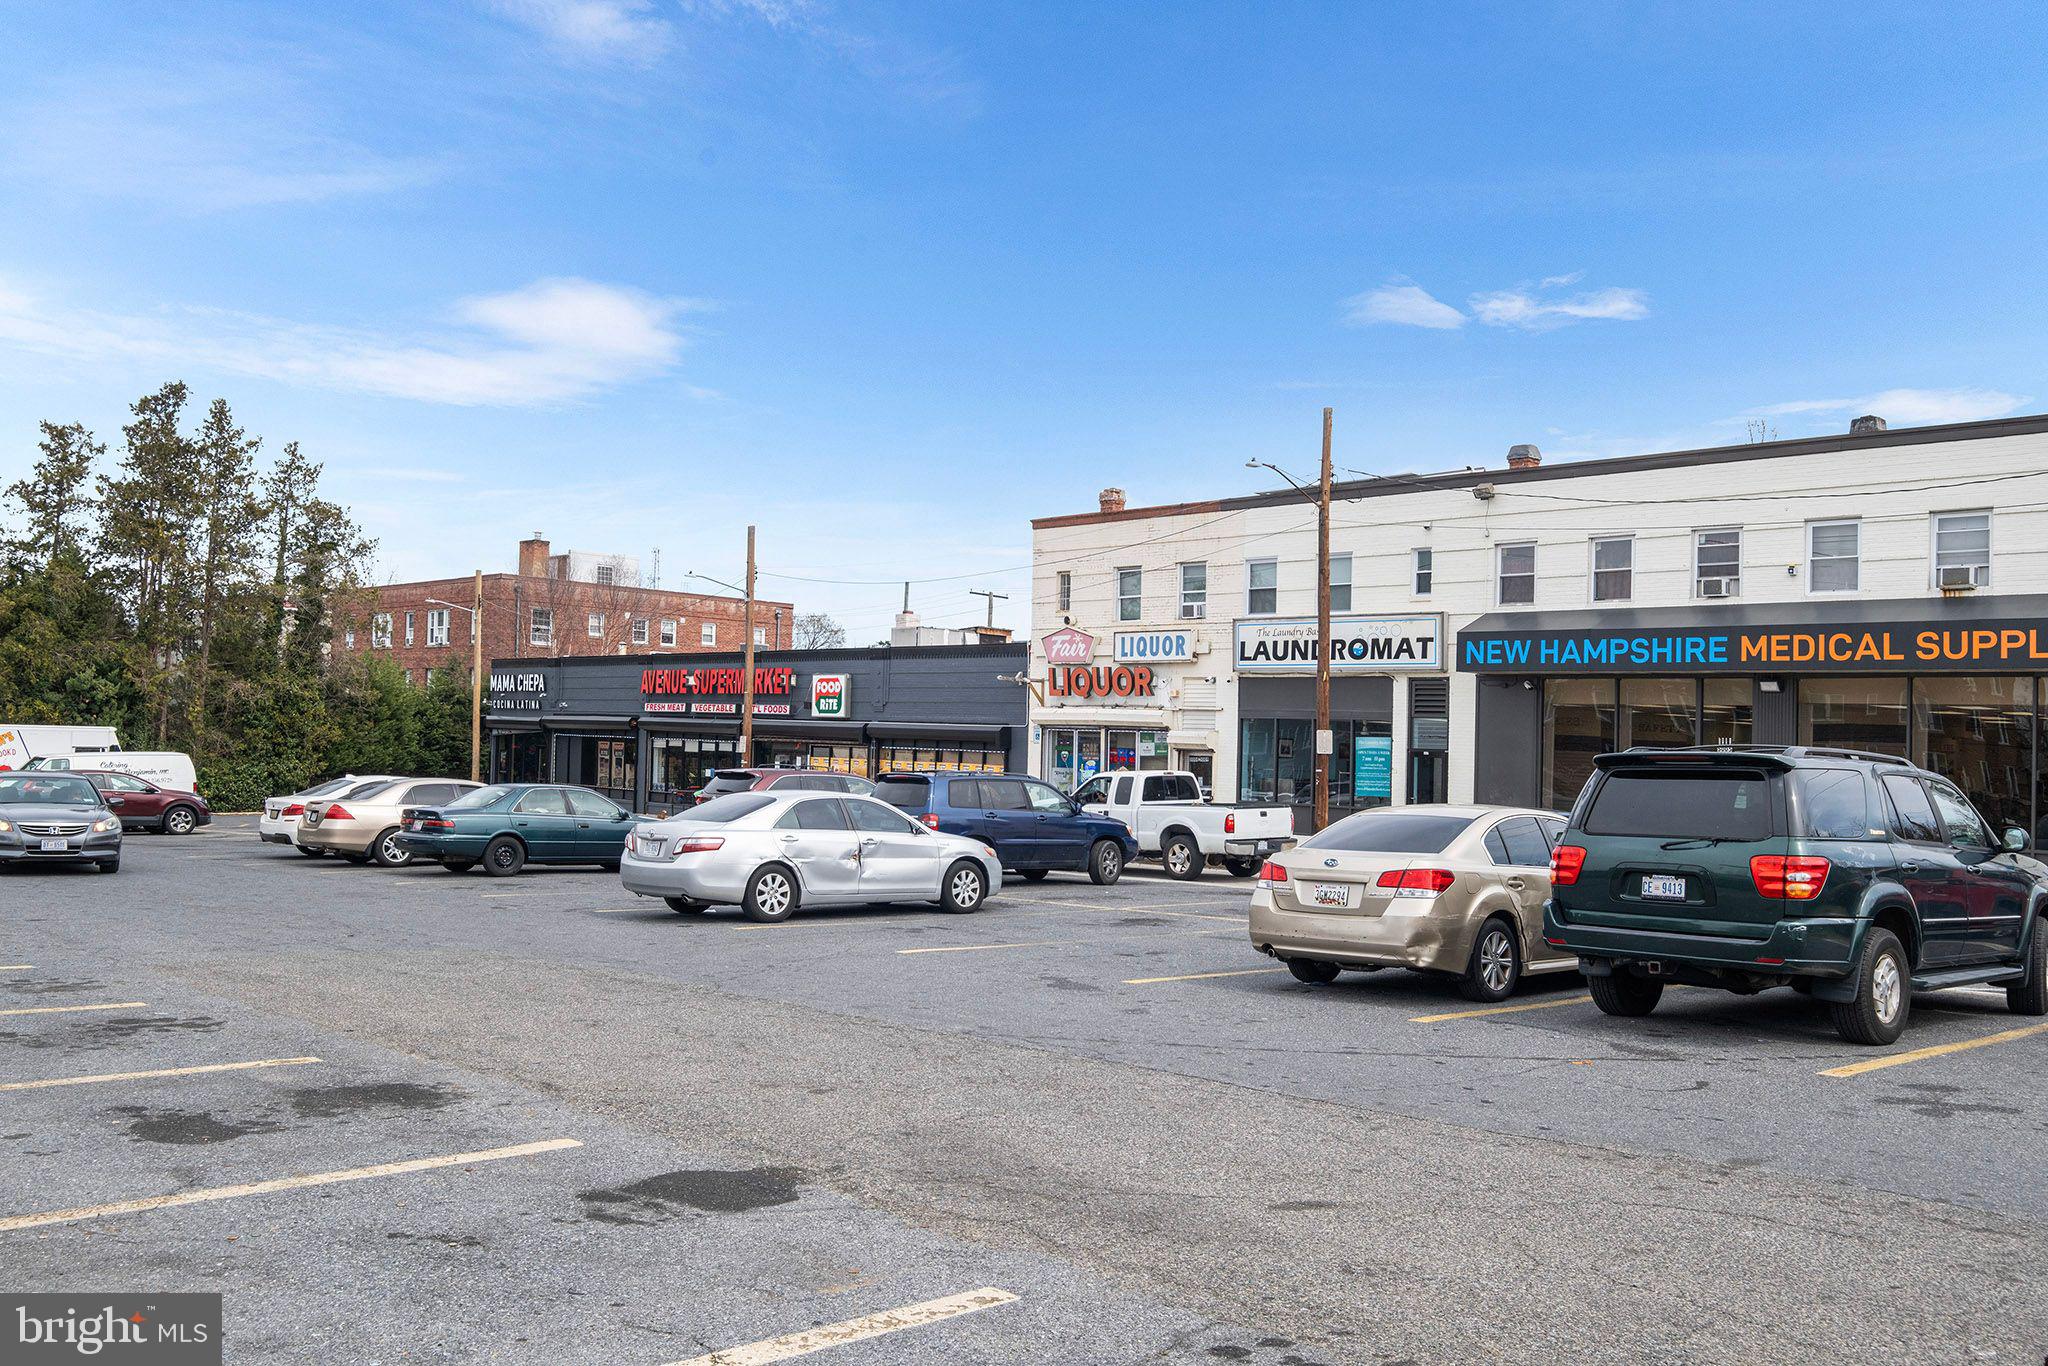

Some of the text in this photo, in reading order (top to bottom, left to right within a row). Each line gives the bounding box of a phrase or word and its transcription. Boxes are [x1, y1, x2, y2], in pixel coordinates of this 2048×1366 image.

[1256, 627, 1270, 637] The
[1272, 626, 1304, 639] Laundry
[1051, 634, 1087, 658] Fair
[1120, 635, 1186, 658] LIQUOR
[1466, 640, 1531, 664] NEW
[1540, 637, 1728, 664] HAMPSHIRE
[1741, 632, 1905, 662] MEDICAL
[490, 673, 545, 692] MAMA CHEPA
[640, 667, 792, 695] AVENUE SUPERMRKET
[816, 681, 841, 693] FOOD
[1048, 666, 1155, 699] LIQUOR
[492, 699, 540, 710] COCINA LATINA
[645, 703, 685, 712] FRESH MEAT
[694, 703, 733, 712] VEGETABLE
[763, 704, 788, 714] FOODS
[1642, 881, 1683, 895] CE 9413
